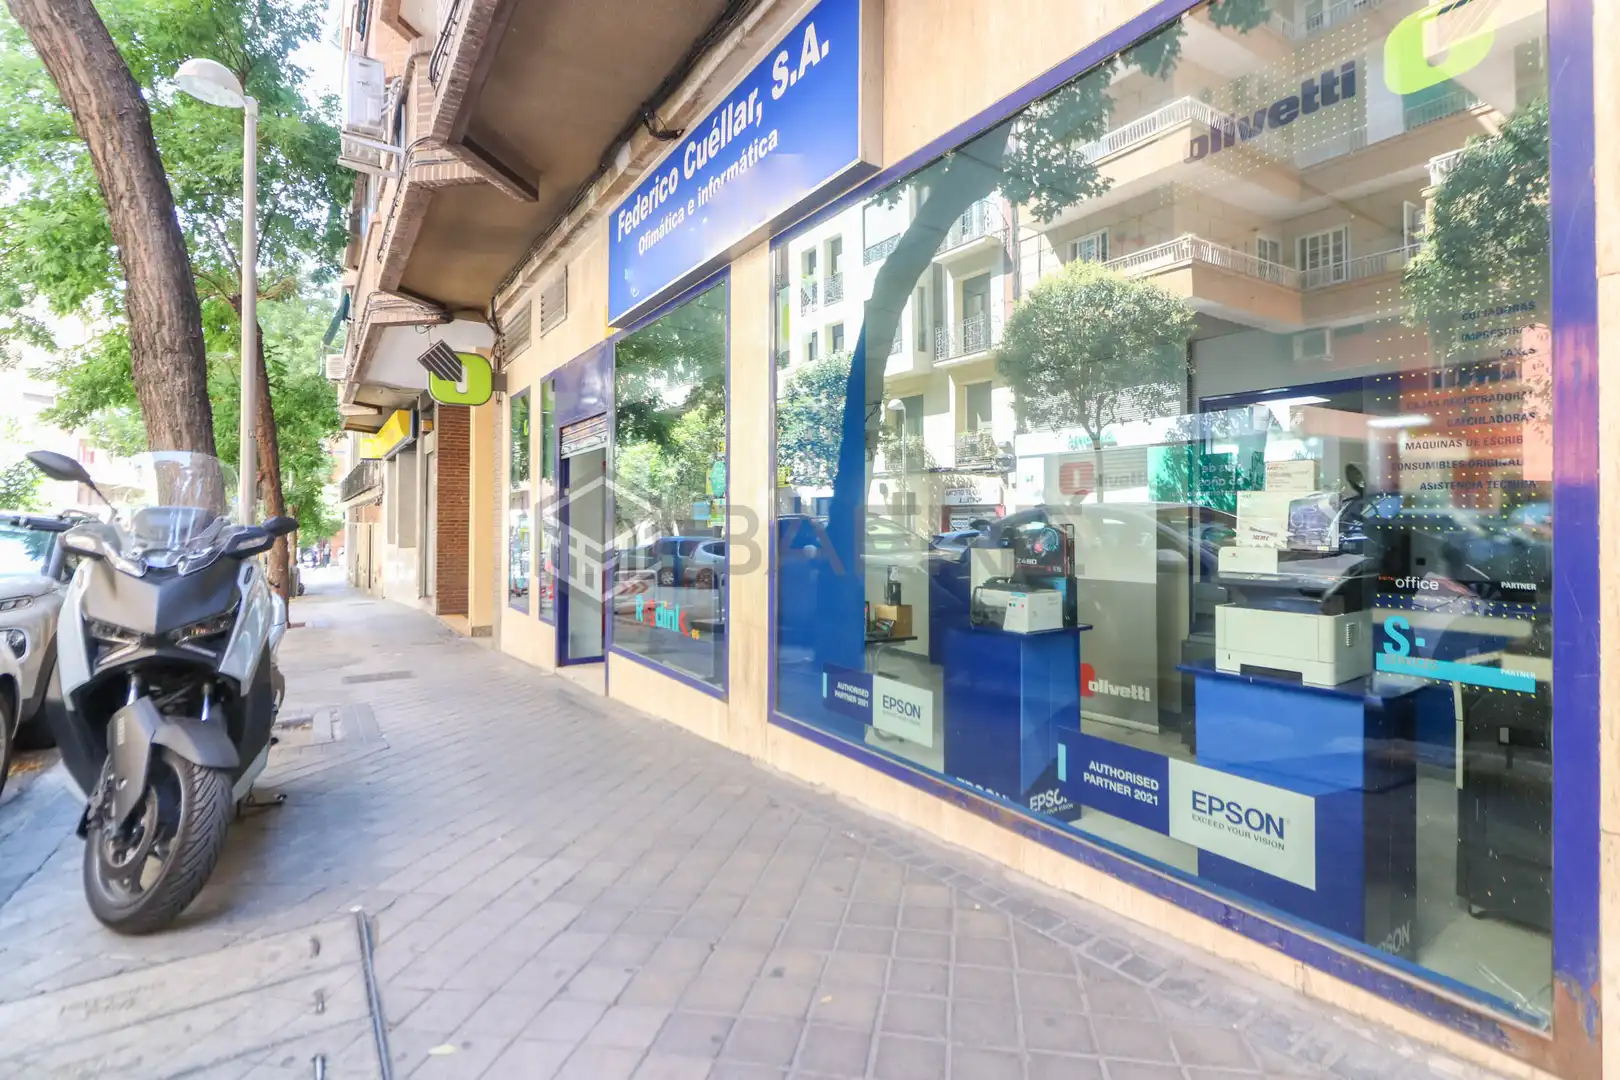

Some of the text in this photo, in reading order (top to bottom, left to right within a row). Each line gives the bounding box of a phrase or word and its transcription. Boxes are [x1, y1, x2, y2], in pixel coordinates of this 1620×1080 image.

[1184, 60, 1356, 164] olivetti
[617, 22, 830, 243] Federico Cuéllar, S.A.
[638, 128, 778, 256] Ofimática e informática
[1405, 438, 1463, 451] MAQUINAS
[1466, 437, 1482, 447] DE
[1420, 480, 1483, 491] ASISTENCIA
[1395, 576, 1439, 590] office
[1500, 580, 1537, 591] PARTNER
[1088, 677, 1151, 702] olivetti
[1500, 668, 1537, 680] PARTNER
[882, 694, 921, 720] EPSON
[1083, 772, 1159, 807] PARTNER 2021
[1089, 760, 1160, 791] AUTHORISED
[1191, 789, 1285, 840] EPSON
[1191, 813, 1286, 852] EXCEED YOUR VISION
